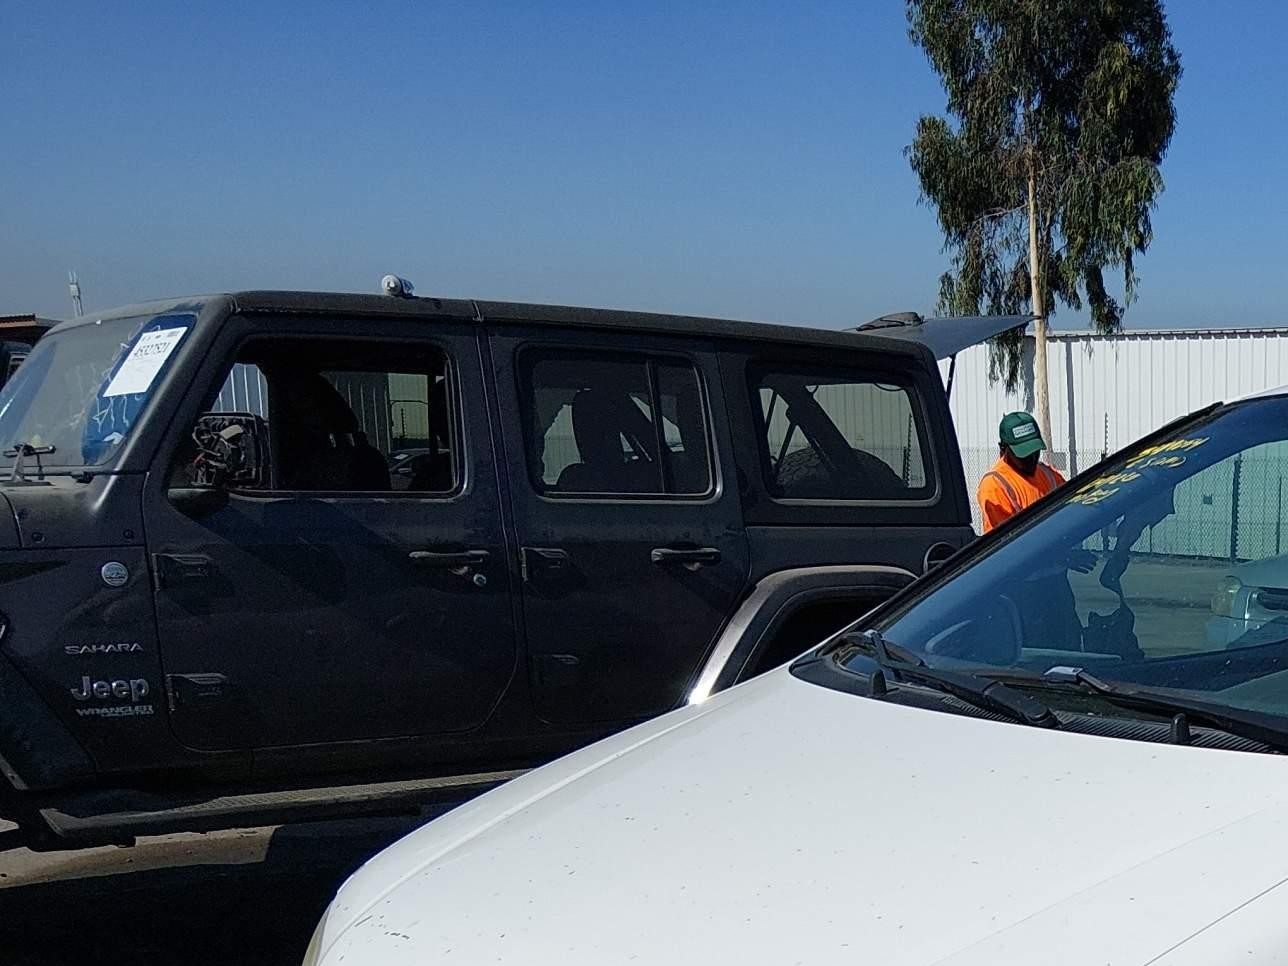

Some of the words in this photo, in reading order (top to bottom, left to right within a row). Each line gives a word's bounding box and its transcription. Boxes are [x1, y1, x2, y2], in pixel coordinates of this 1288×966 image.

[64, 642, 144, 655] SAHARA
[70, 675, 151, 703] Jeep
[75, 704, 155, 717] WRANGLER
